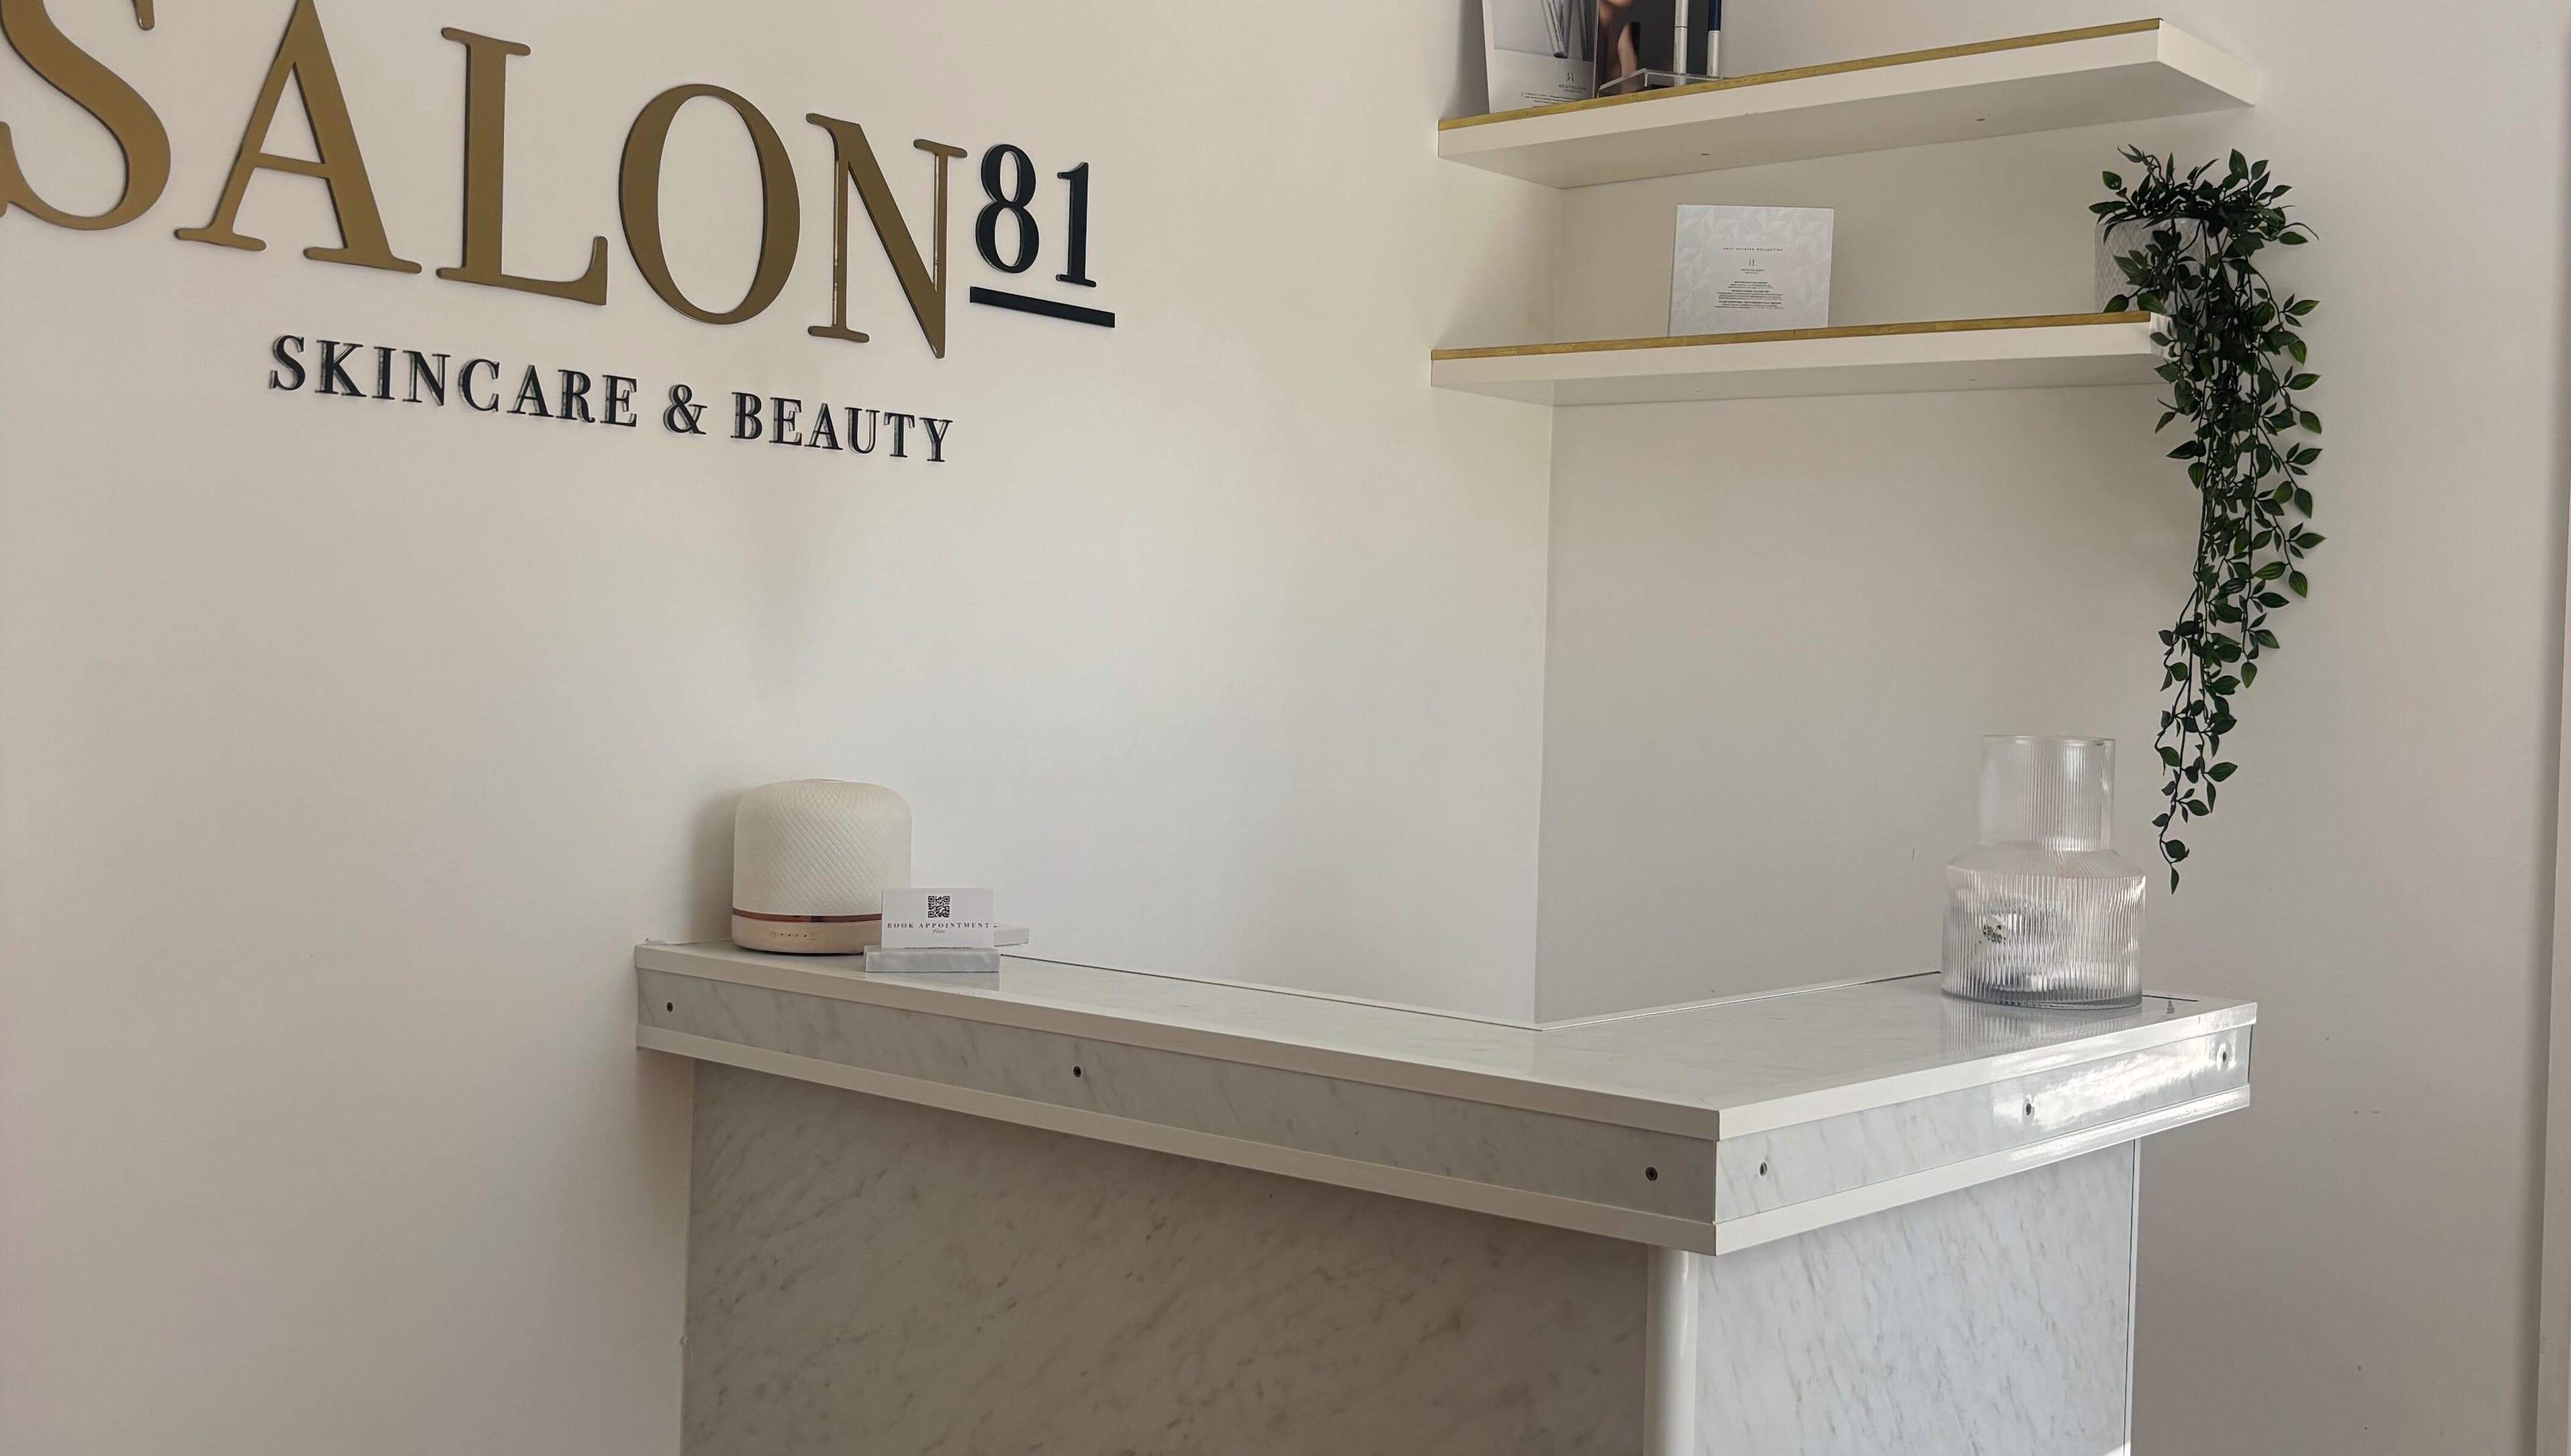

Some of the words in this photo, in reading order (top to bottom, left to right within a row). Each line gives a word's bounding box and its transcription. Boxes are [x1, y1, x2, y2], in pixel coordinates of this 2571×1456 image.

[0, 0, 967, 358] SALON
[976, 143, 1097, 288] 81
[269, 335, 637, 428] SKINCARE
[663, 384, 707, 435] &
[730, 391, 953, 463] BEAUTY
